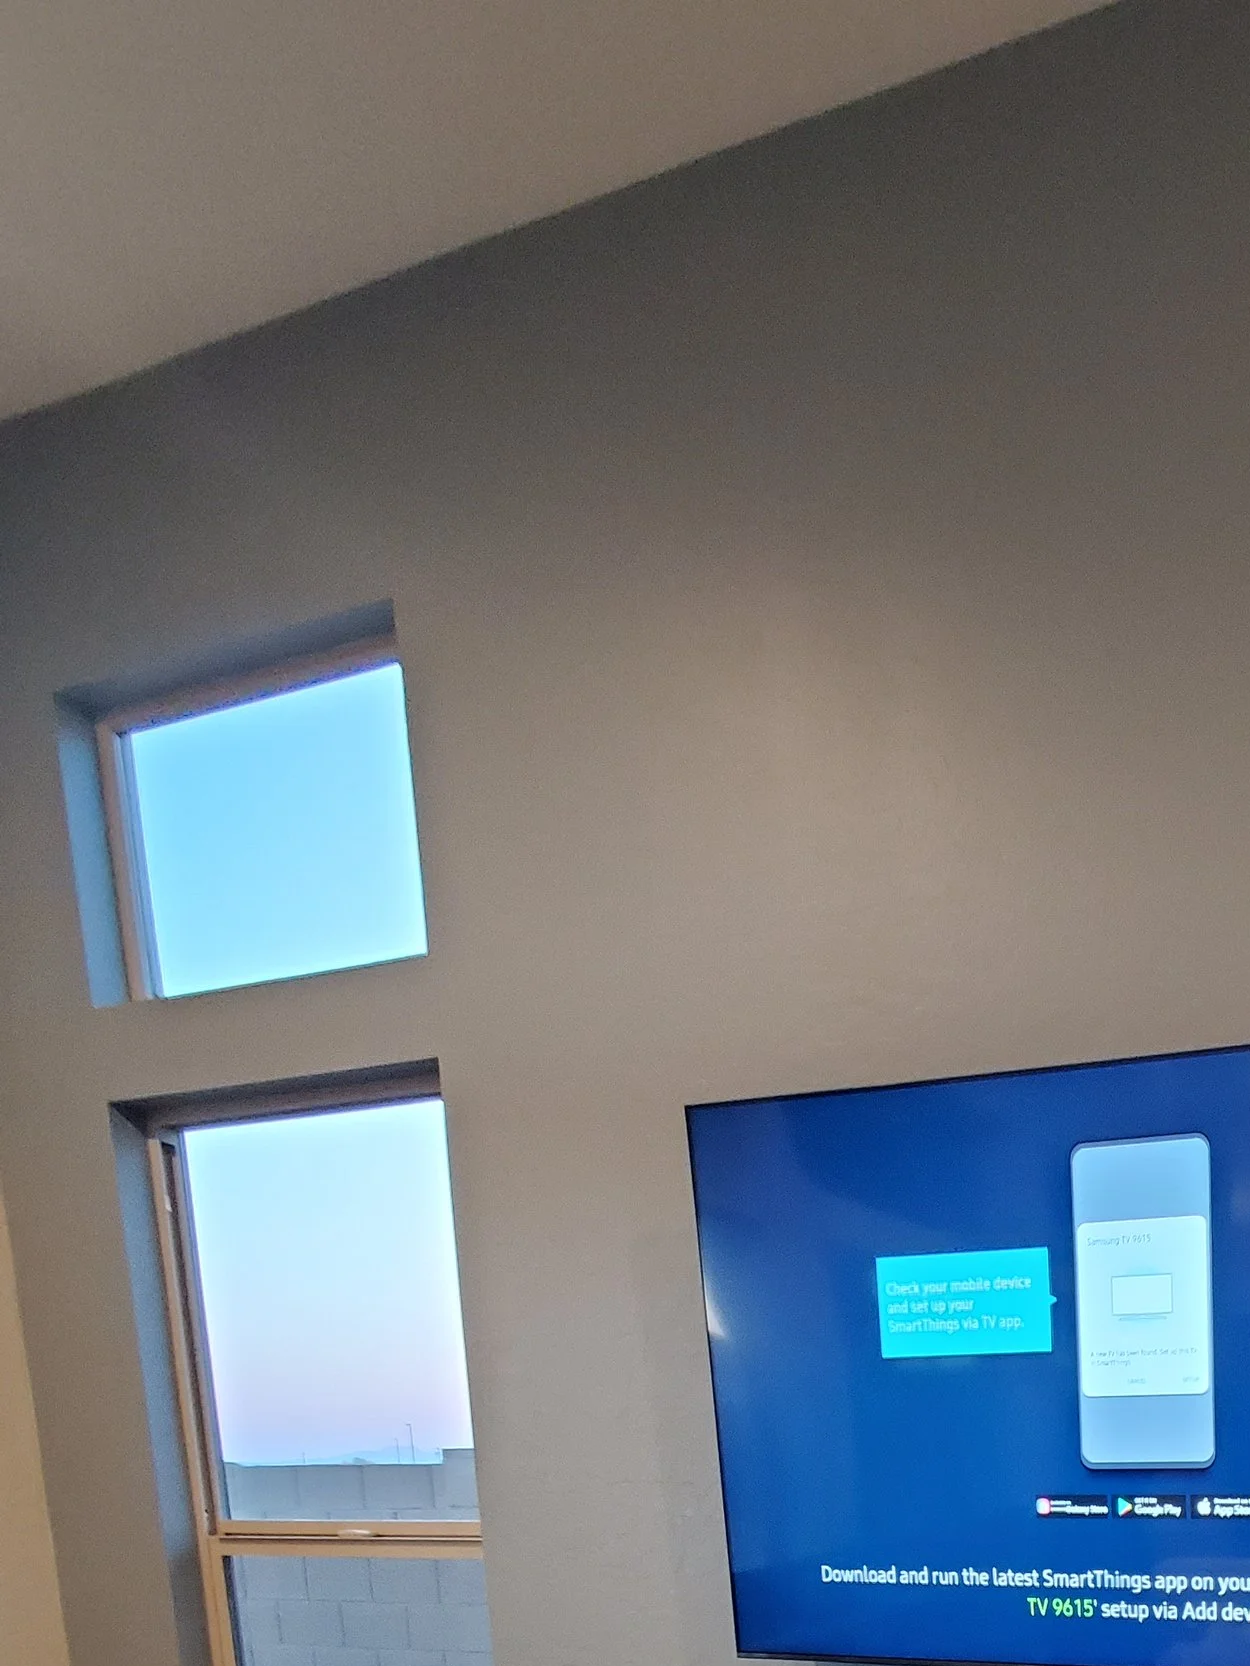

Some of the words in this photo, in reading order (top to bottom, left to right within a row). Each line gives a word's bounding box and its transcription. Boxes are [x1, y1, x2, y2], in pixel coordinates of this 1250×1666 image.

[885, 1280, 920, 1296] Check
[922, 1282, 948, 1297] your
[951, 1277, 990, 1293] mobile
[993, 1276, 1032, 1291] device
[887, 1300, 908, 1314] and
[911, 1300, 929, 1314] set
[932, 1302, 946, 1315] up
[949, 1300, 974, 1314] your
[888, 1317, 960, 1334] SmartThings
[962, 1316, 979, 1331] via
[981, 1315, 997, 1329] TV
[1000, 1316, 1025, 1332] app.
[1134, 1503, 1163, 1517] Google
[1164, 1503, 1181, 1518] Play
[1213, 1504, 1233, 1518] App
[820, 1565, 897, 1584] Download
[899, 1566, 929, 1586] and
[932, 1570, 959, 1587] run
[962, 1567, 989, 1588] the
[992, 1568, 1040, 1588] latest
[1042, 1569, 1151, 1594] SmartThings
[1154, 1574, 1188, 1594] app
[1191, 1575, 1213, 1592] on
[1027, 1597, 1049, 1617] TV
[1052, 1597, 1098, 1619] 9615'
[1101, 1601, 1150, 1623] setup
[1152, 1600, 1179, 1621] via
[1181, 1600, 1217, 1622] Add
